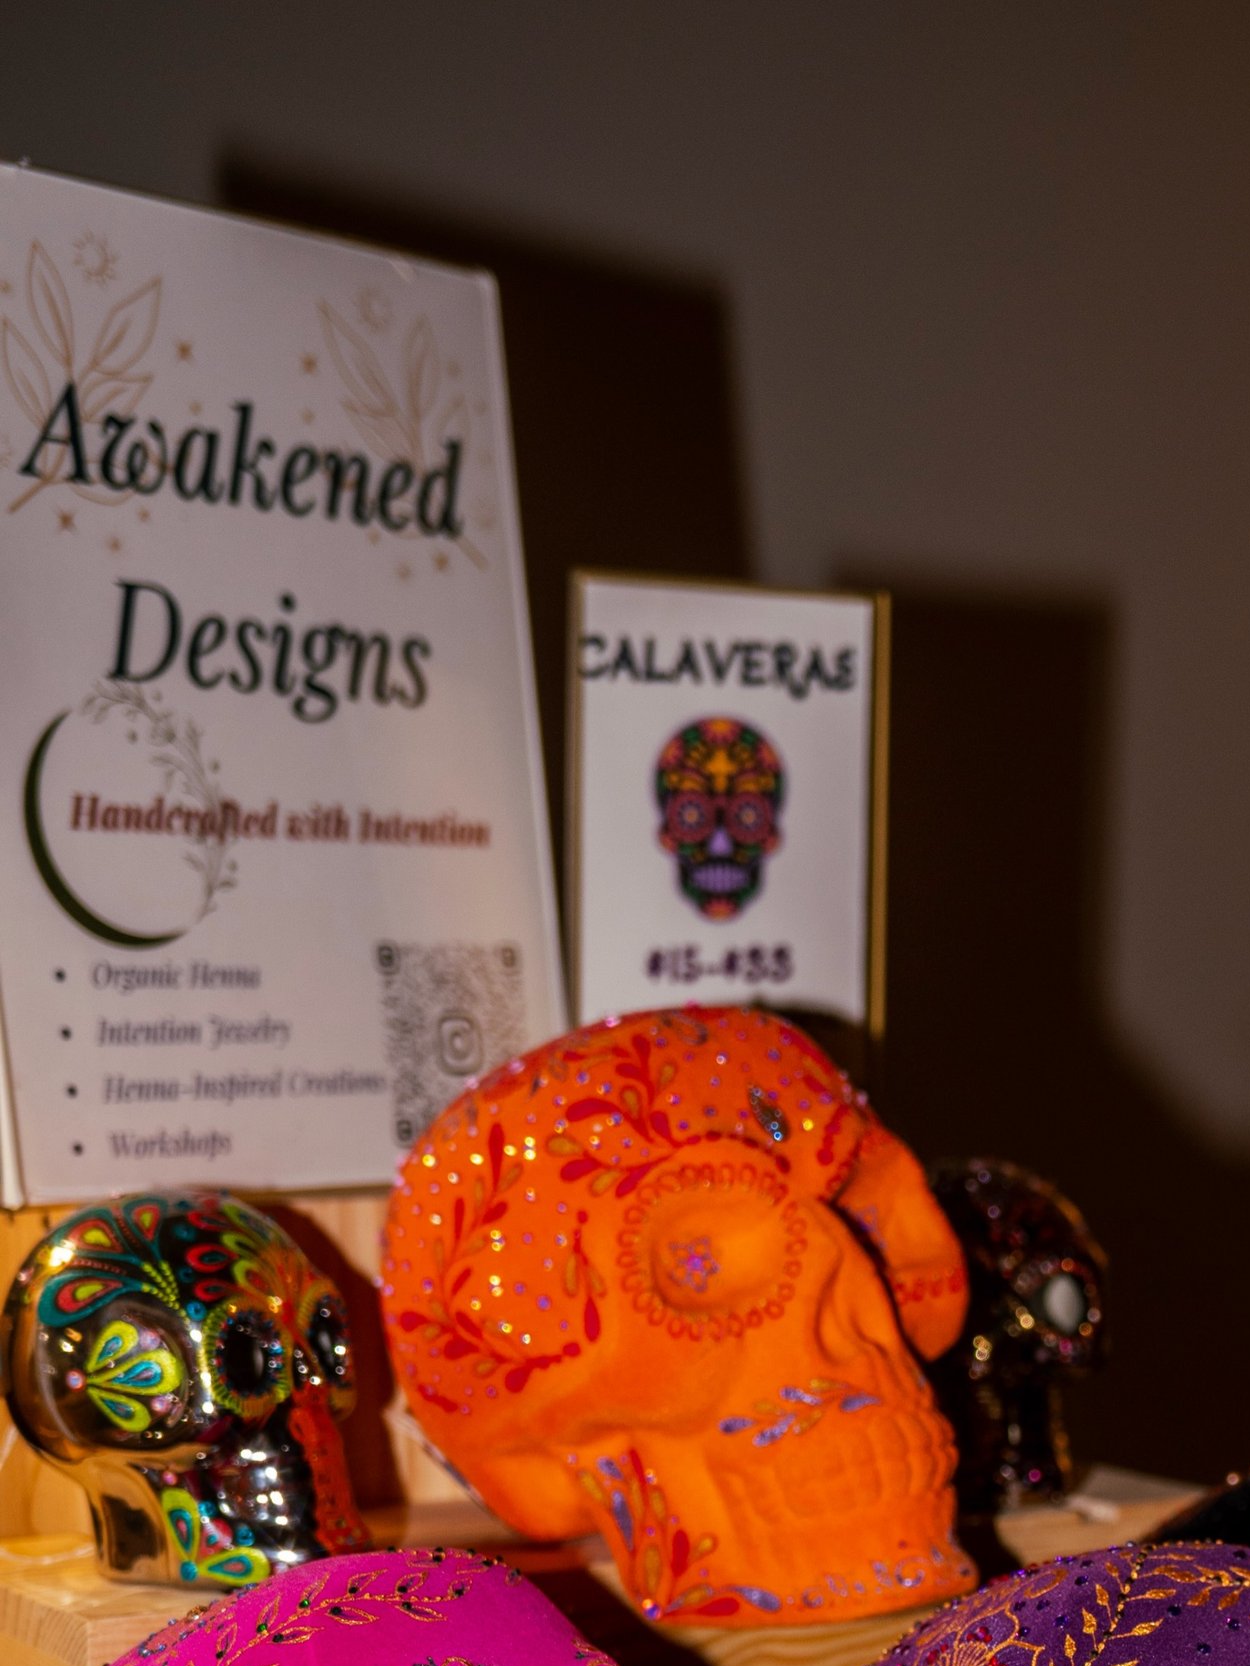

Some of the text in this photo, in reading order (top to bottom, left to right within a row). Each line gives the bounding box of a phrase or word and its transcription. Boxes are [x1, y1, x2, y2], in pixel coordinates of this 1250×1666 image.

[19, 381, 464, 540] Awakened
[106, 577, 432, 724] Designs
[578, 634, 855, 701] CALAVERAS
[70, 793, 492, 848] Handcrafted with Intention
[92, 960, 262, 994] Organic Henna
[97, 1013, 292, 1050] Intention Jewelry
[109, 1130, 232, 1161] Workshops
